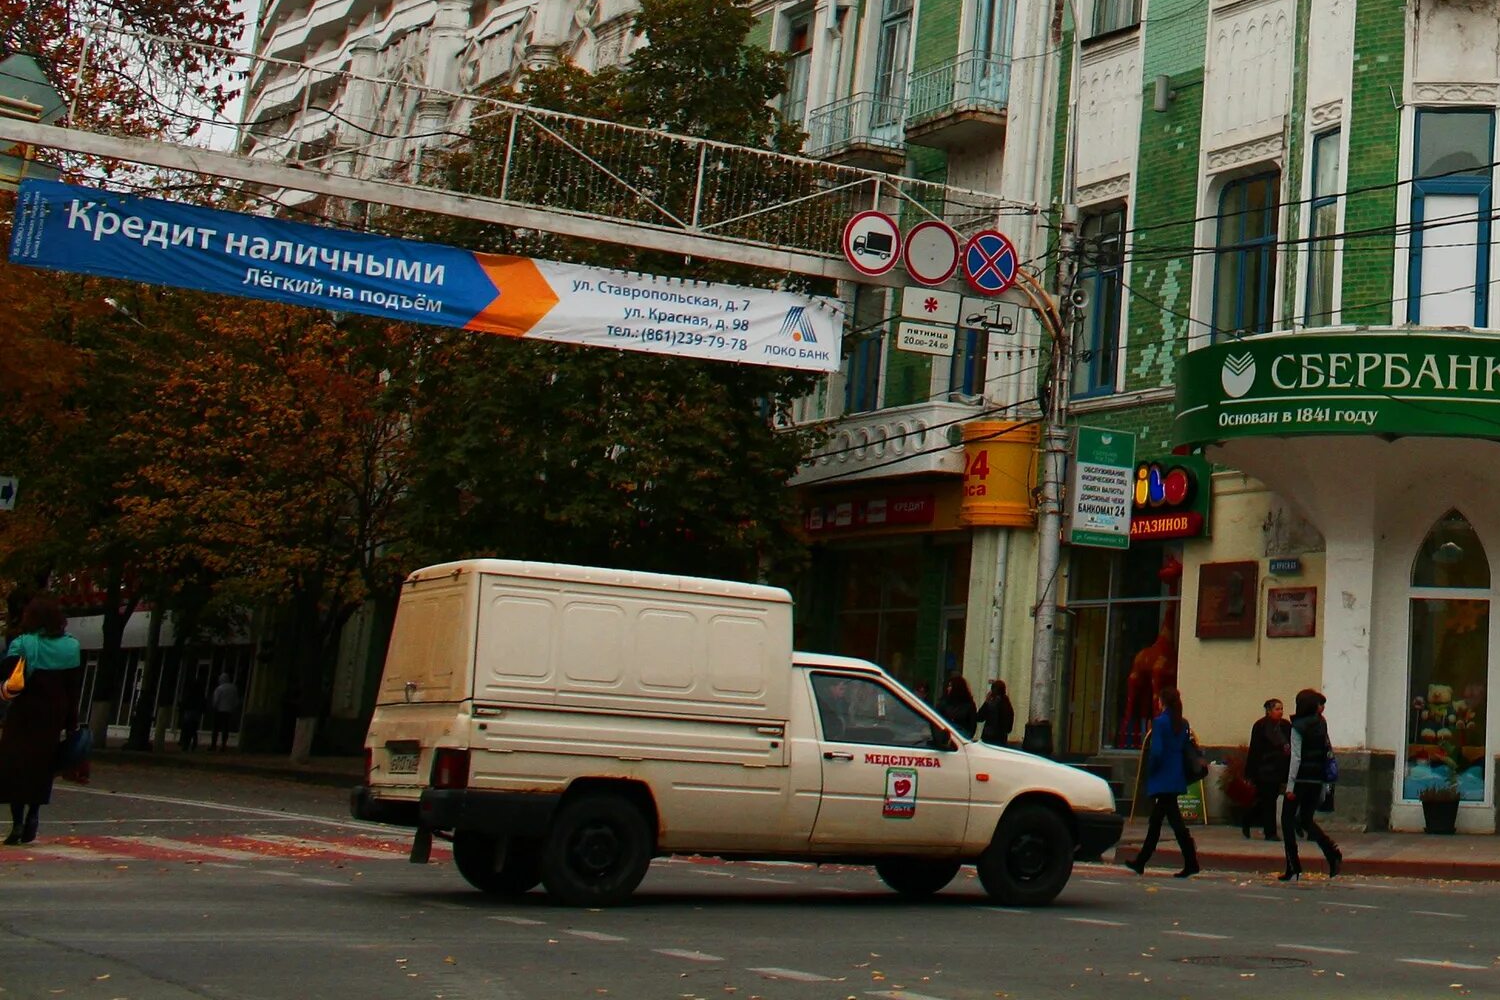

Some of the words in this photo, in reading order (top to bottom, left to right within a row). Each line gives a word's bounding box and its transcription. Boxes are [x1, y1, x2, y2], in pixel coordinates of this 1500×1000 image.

[67, 199, 217, 250] Кредит
[225, 230, 445, 286] наличными
[242, 267, 324, 296] Лёгкий
[328, 284, 353, 302] на
[359, 288, 443, 314] подъём
[572, 278, 594, 293] ул.
[597, 280, 722, 310] Ставропольская,
[725, 300, 739, 313] д.
[742, 300, 750, 312] 7
[623, 307, 645, 320] ул.
[649, 307, 713, 329] Красная,
[715, 318, 729, 332] д.
[732, 318, 749, 332] 98
[607, 324, 639, 339] тел.:
[641, 328, 748, 351] (861)239-79-78
[764, 344, 797, 358] ЛОКО
[799, 347, 830, 361] БАНК
[1218, 407, 1278, 427] Основан
[1282, 410, 1292, 423] в
[1296, 406, 1330, 423] 1841
[1334, 410, 1379, 426] году
[1078, 502, 1114, 516] БАНКОМАТ
[1114, 505, 1126, 518] 24
[1130, 516, 1188, 535] АГАЗИНОВ
[864, 753, 941, 769] МЕДСЛУЖБА
